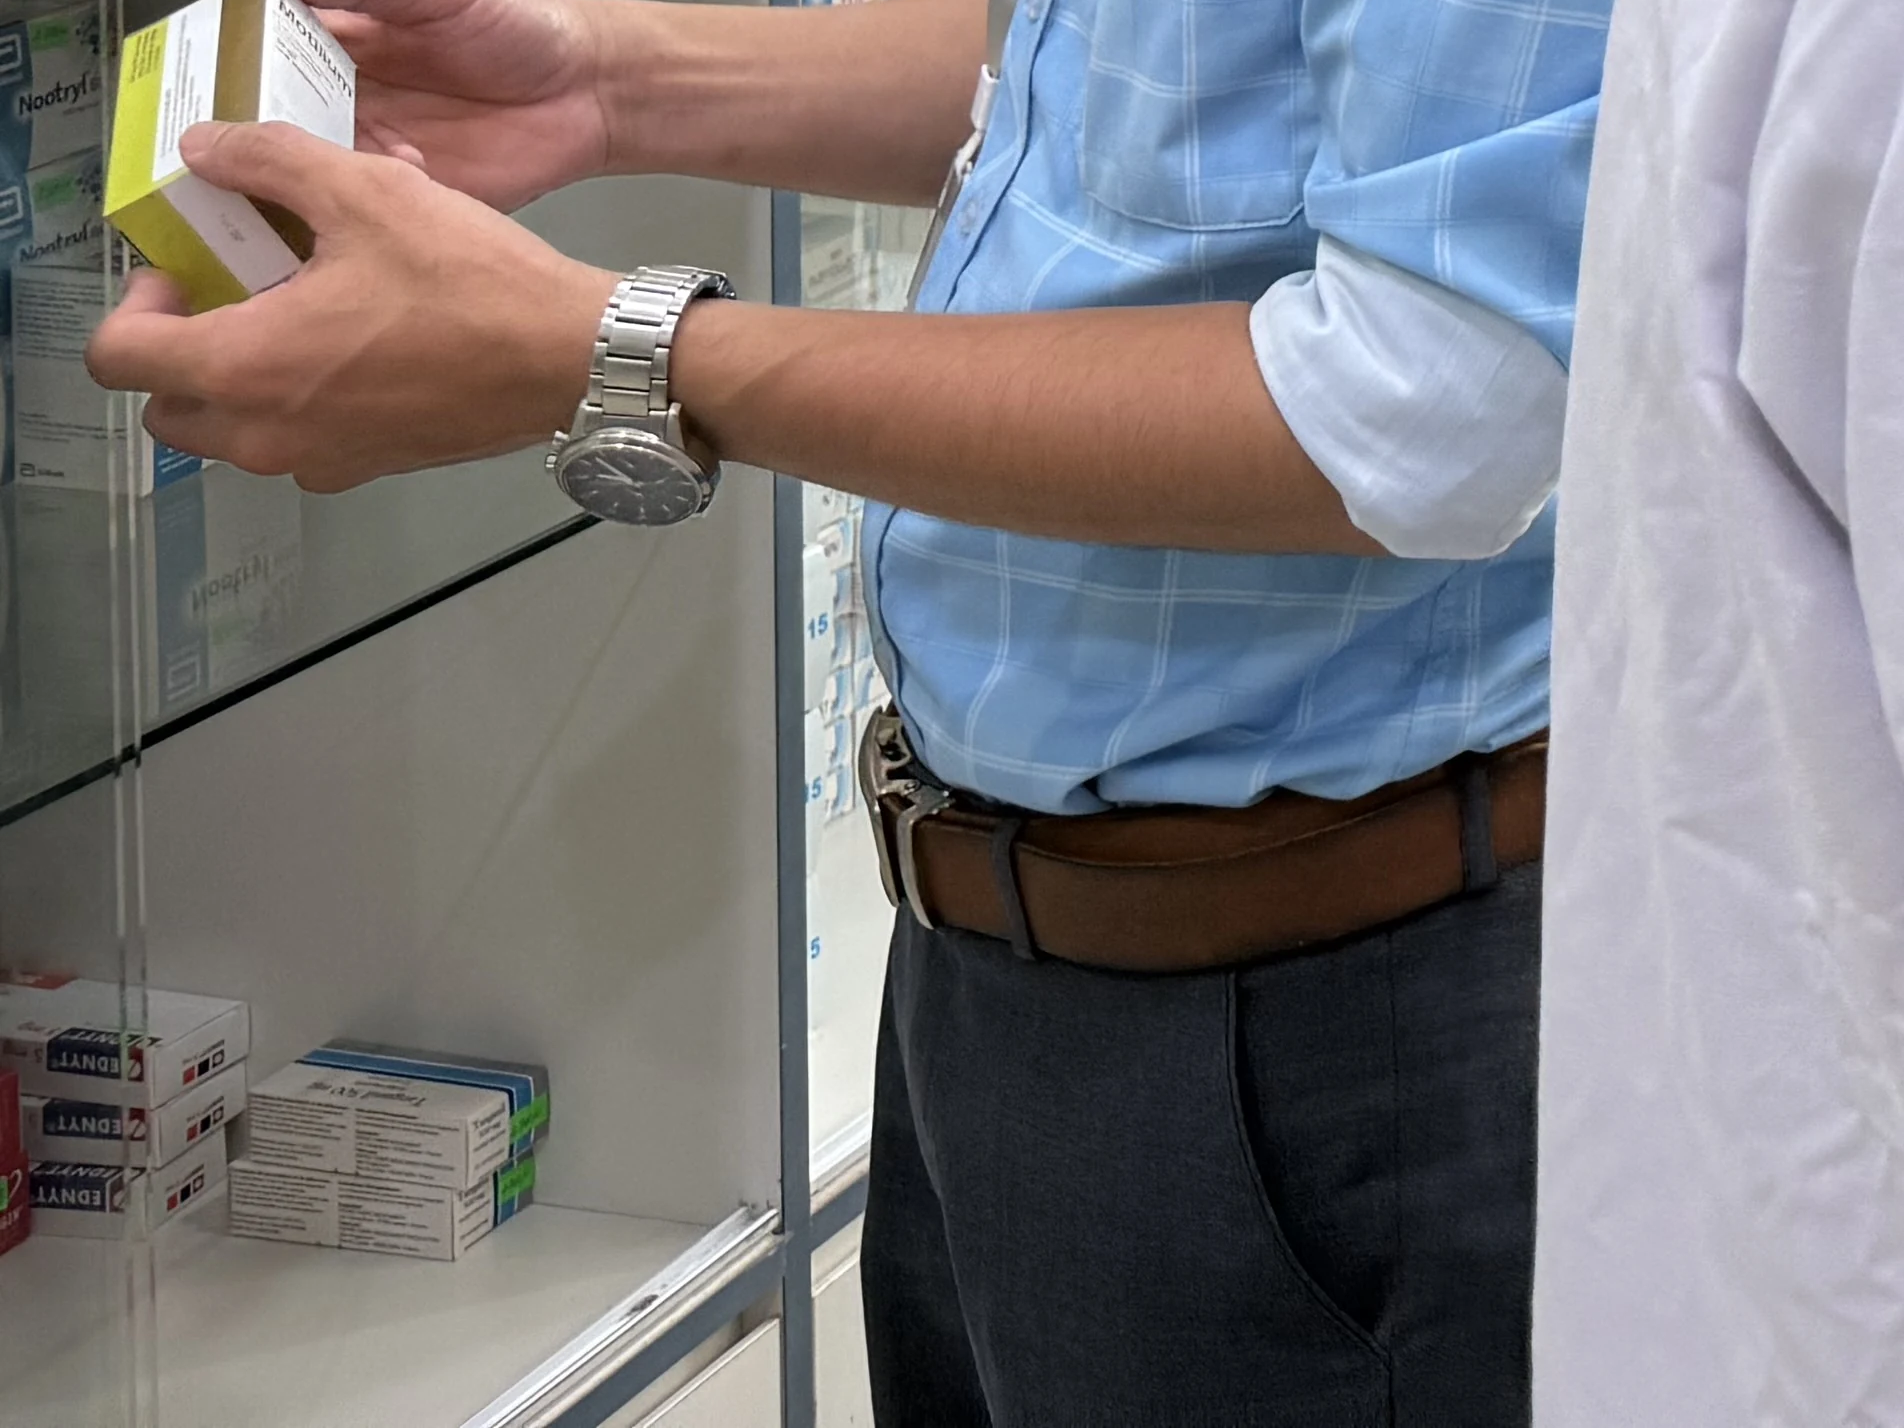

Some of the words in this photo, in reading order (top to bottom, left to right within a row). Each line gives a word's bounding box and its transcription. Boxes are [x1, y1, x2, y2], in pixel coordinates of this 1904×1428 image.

[18, 70, 89, 117] Nootryl
[807, 612, 829, 638] 15
[58, 1053, 121, 1074] EDNYT
[56, 1115, 122, 1134] EDNYT
[37, 1185, 101, 1205] EDNYT
